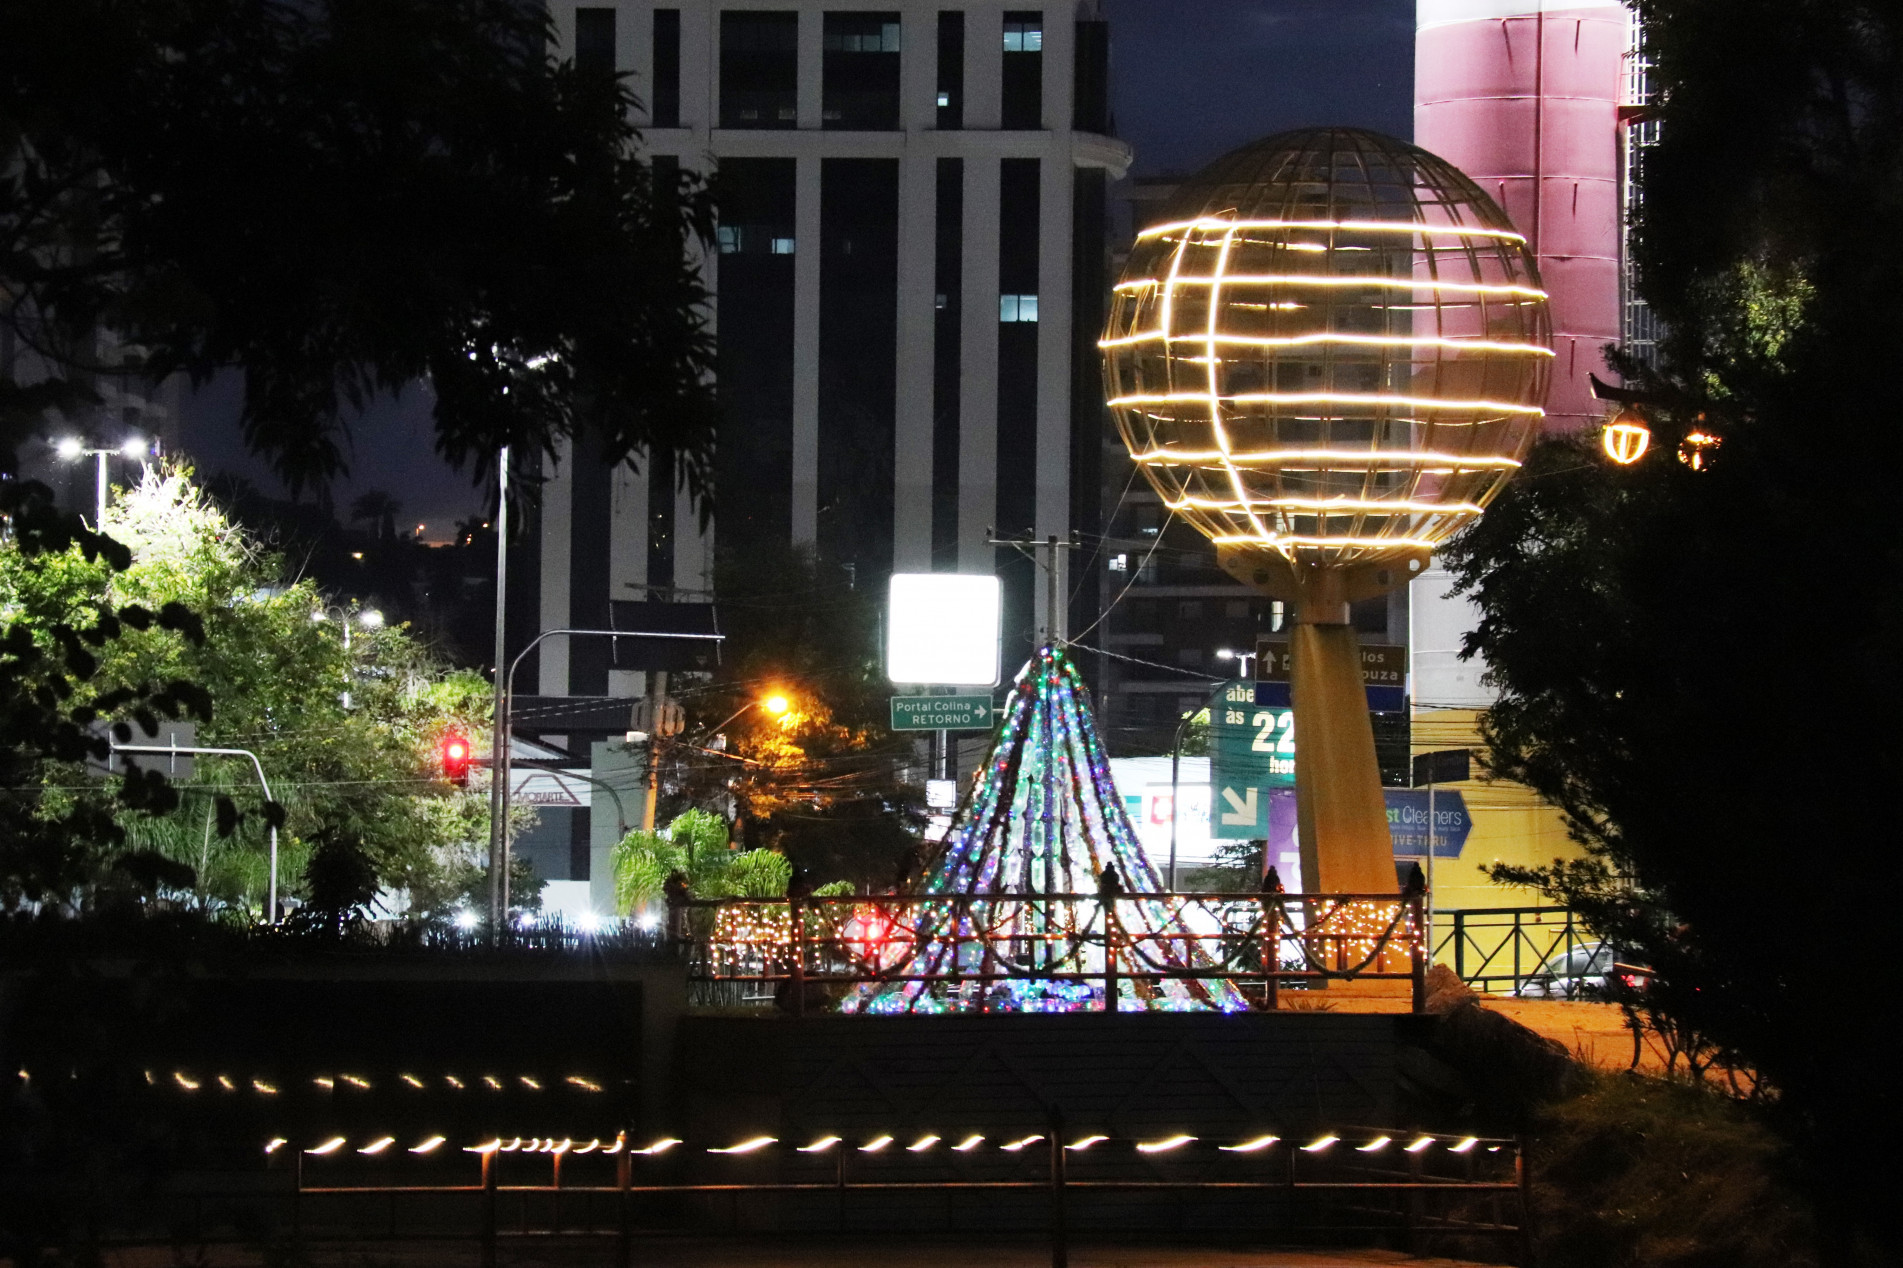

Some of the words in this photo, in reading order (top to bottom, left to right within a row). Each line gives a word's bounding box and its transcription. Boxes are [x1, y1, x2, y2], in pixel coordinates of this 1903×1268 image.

[1360, 651, 1385, 663] los
[1226, 684, 1255, 703] abe
[896, 702, 932, 713] Portal
[934, 701, 971, 711] Colina
[912, 713, 971, 725] RETORNO
[1225, 706, 1245, 725] às
[1251, 711, 1296, 753] 22
[1402, 805, 1462, 826] Cleaners
[1391, 834, 1448, 847] IVE-THRU
